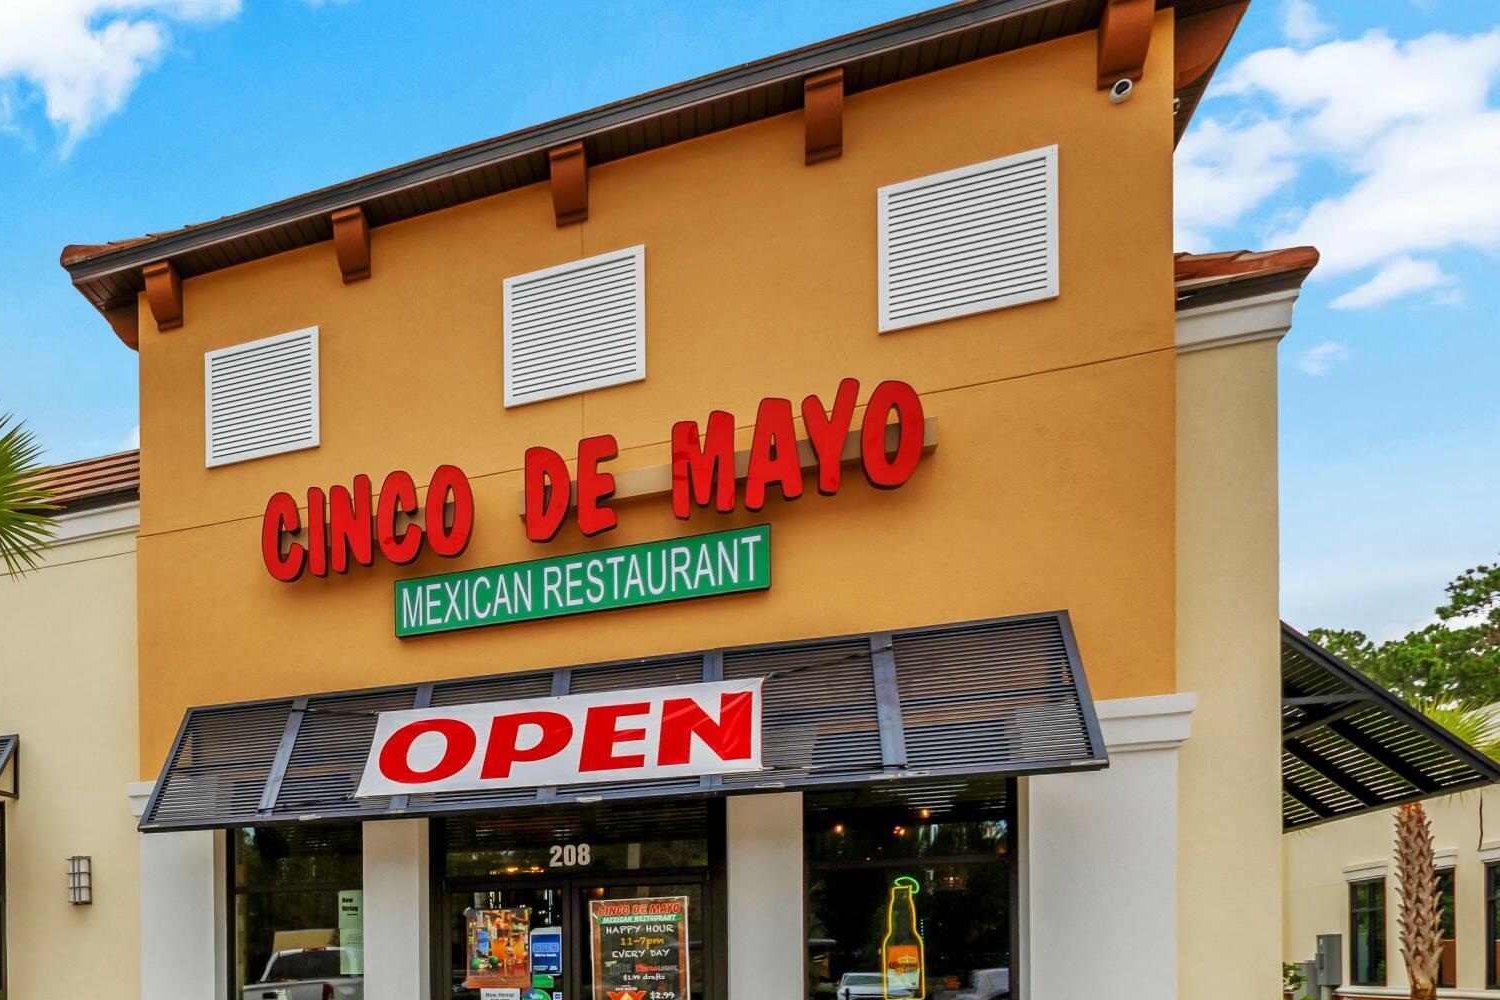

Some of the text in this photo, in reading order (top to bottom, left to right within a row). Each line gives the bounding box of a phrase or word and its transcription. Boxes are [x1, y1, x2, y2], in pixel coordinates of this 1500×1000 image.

[261, 377, 925, 582] CINCO DE MAYO
[401, 534, 763, 629] MEXICAN RESTAURANT
[377, 690, 753, 784] OPEN
[549, 843, 591, 868] 208
[598, 902, 681, 916] CINCO DE MAYO
[602, 914, 677, 924] MEXICAN RESTAURANT
[605, 924, 675, 935] HAPPY HOUR
[620, 936, 665, 950] 11-7pm
[611, 949, 670, 958] EVERY DAY
[622, 973, 666, 982] $1.99 drafts
[649, 991, 675, 1000] $2.99
